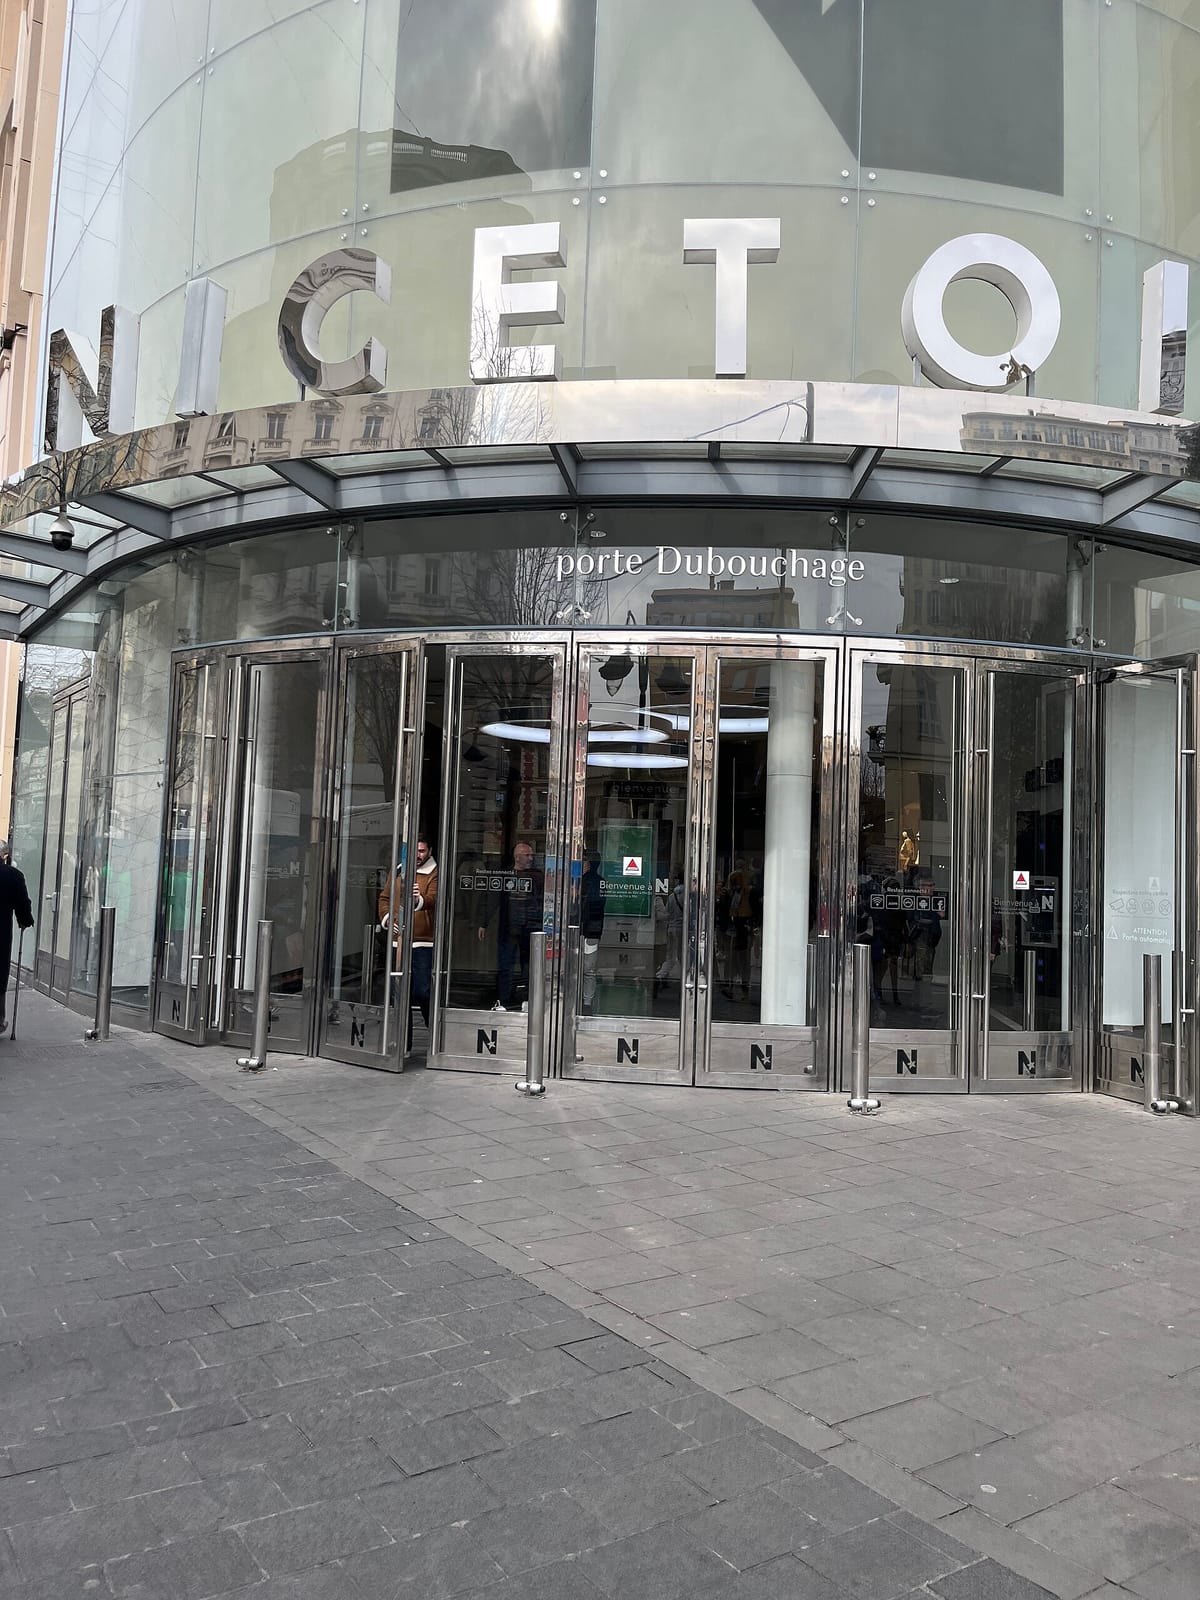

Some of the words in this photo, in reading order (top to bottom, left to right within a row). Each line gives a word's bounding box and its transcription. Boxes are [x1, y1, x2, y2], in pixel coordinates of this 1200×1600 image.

[555, 550, 643, 582] porte
[655, 545, 866, 587] Dubouchage
[599, 880, 646, 891] Bienvenue
[647, 881, 653, 891] à
[1133, 927, 1168, 936] ATTENTION
[350, 1020, 365, 1047] N
[476, 1029, 498, 1055] N
[616, 1037, 640, 1064] N
[749, 1043, 773, 1070] N
[896, 1049, 918, 1075] N
[1017, 1050, 1036, 1076] N
